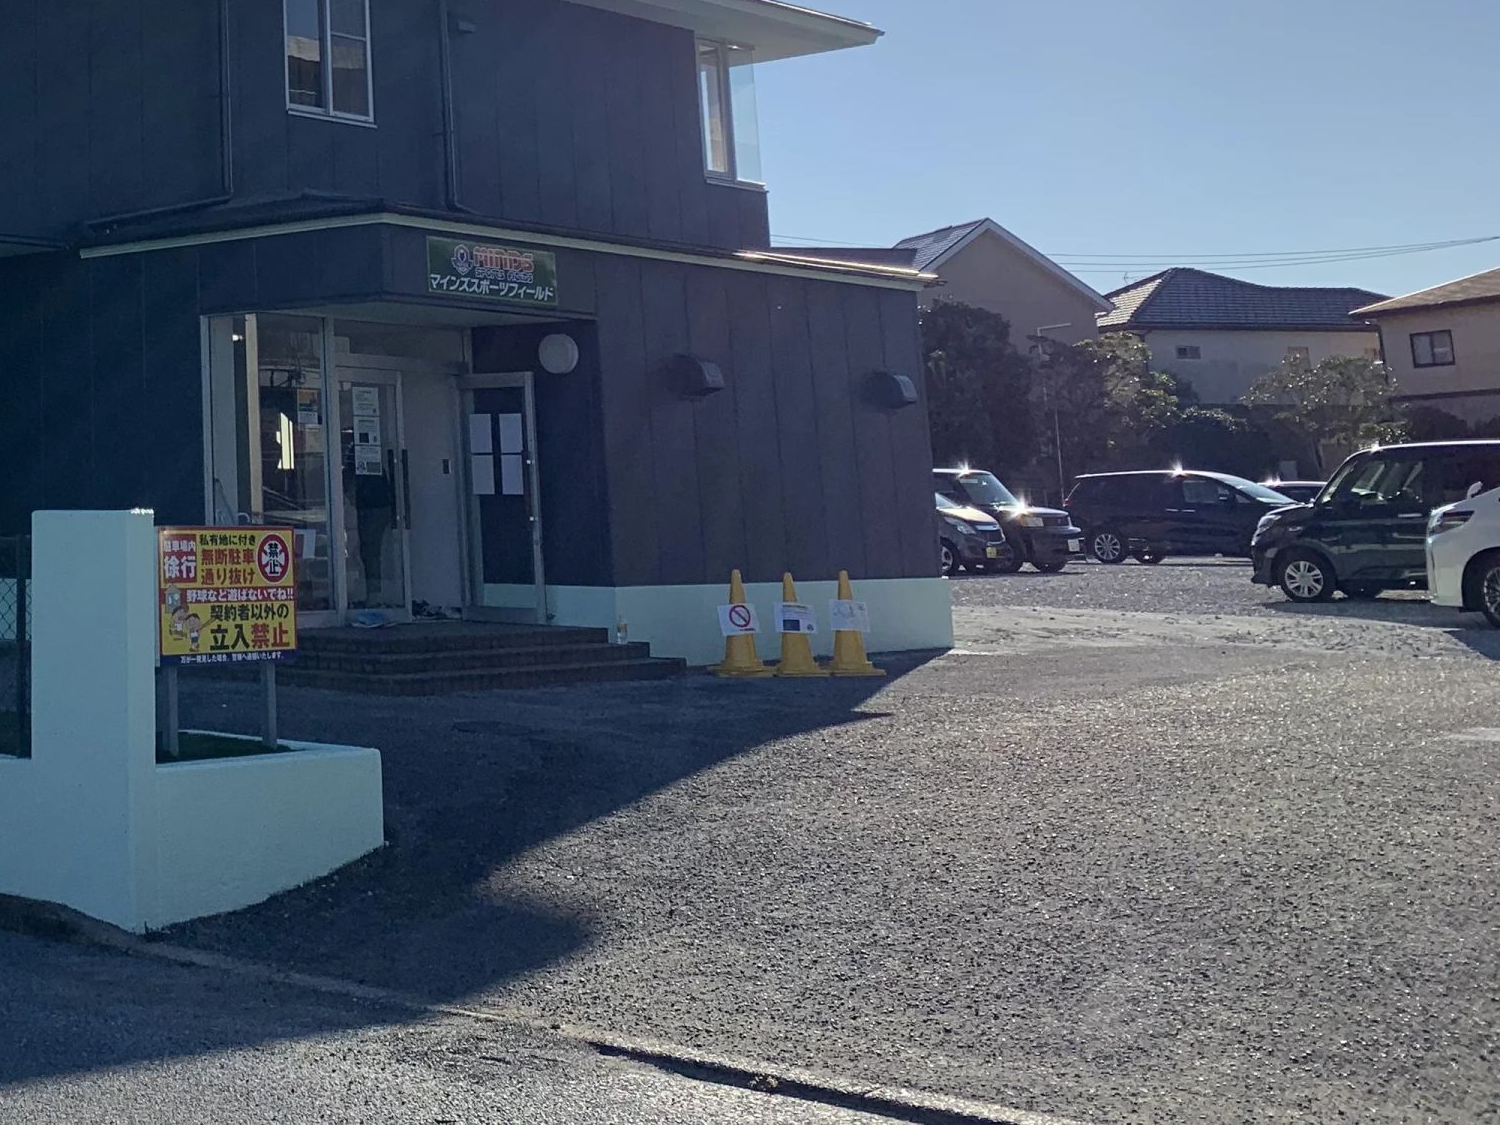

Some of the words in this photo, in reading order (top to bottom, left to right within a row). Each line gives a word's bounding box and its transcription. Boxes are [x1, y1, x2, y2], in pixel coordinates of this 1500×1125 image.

[430, 273, 554, 301] マインズスポーツフィールド
[200, 533, 256, 547] 私有地に付き
[164, 555, 197, 579] 徐行
[201, 548, 255, 566] 無断駐車
[267, 541, 280, 575] 禁止
[201, 567, 256, 586] 通り抜け
[210, 603, 289, 622] 契約者以外の
[210, 623, 290, 651] 立入禁止
